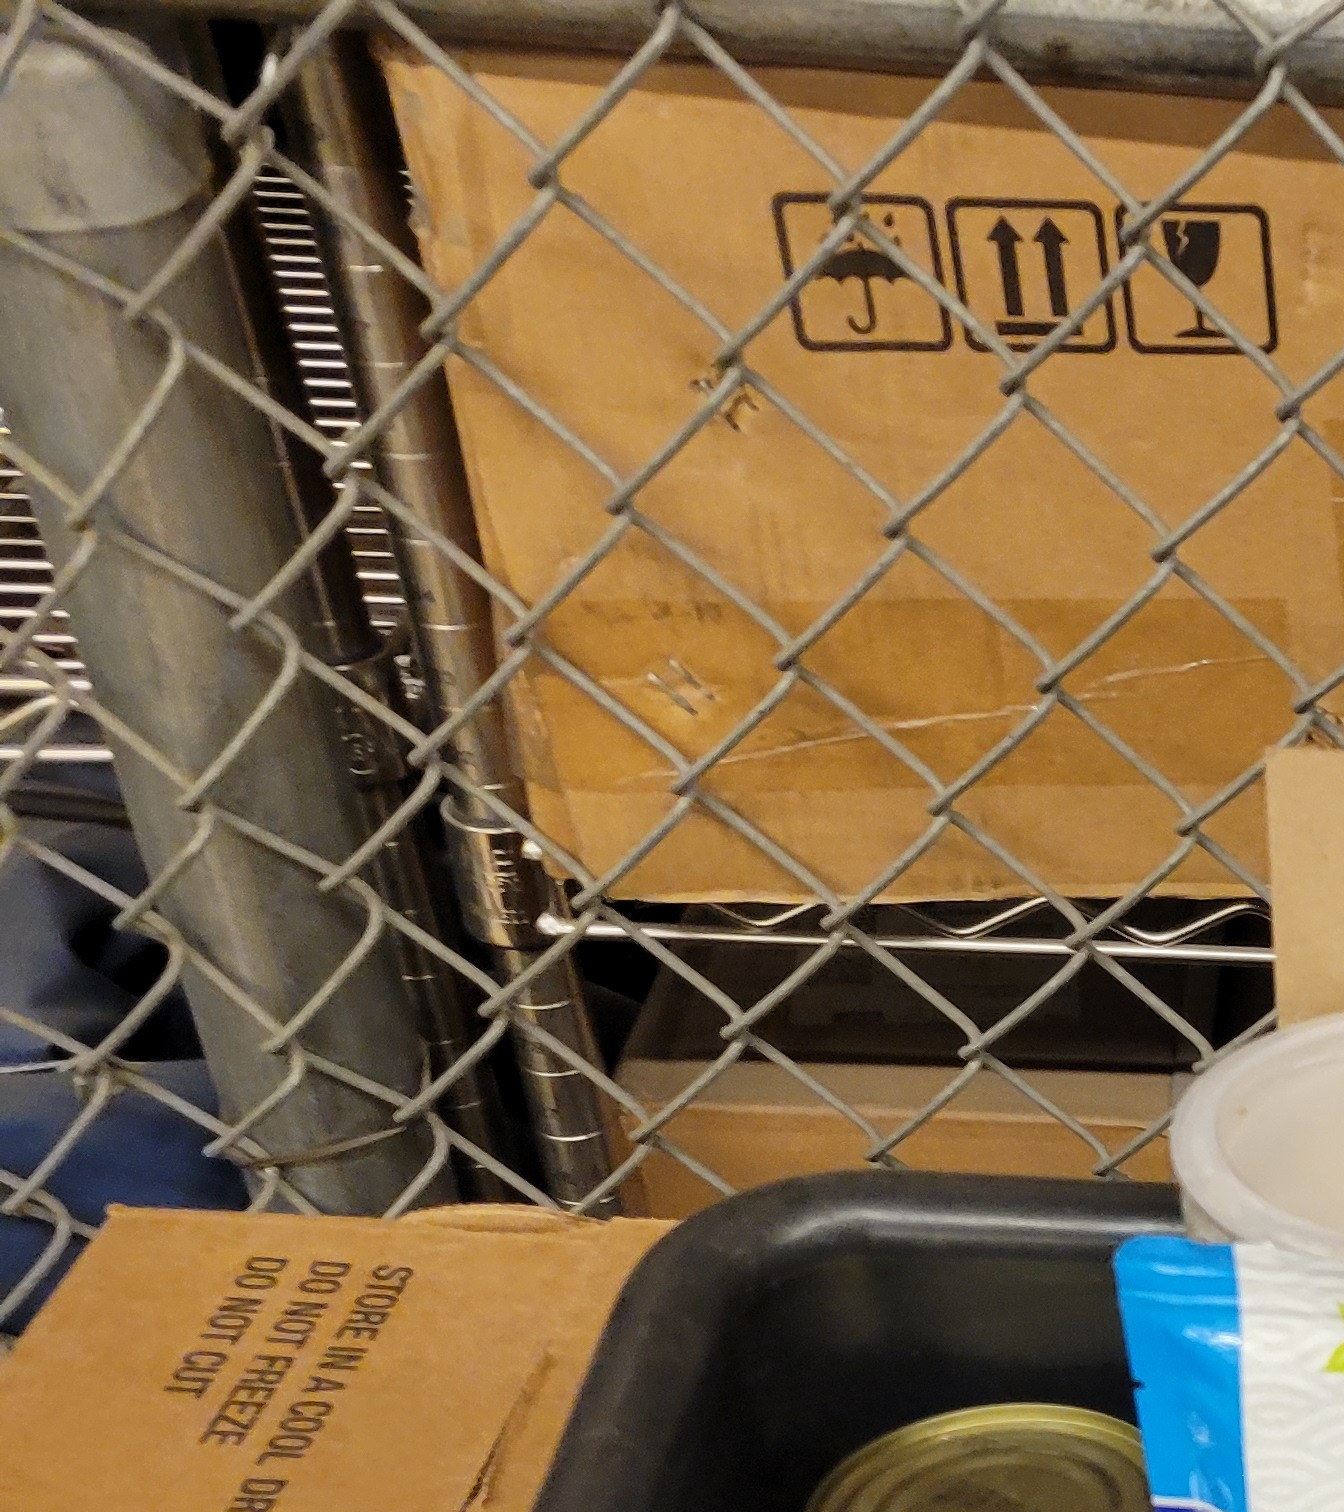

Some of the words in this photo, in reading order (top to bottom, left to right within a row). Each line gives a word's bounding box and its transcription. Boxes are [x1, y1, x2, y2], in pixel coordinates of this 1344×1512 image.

[234, 1255, 290, 1291] DO
[298, 1259, 354, 1295] DO
[200, 1296, 264, 1346] NOT
[264, 1300, 330, 1350] NOT
[333, 1264, 415, 1342] STORE
[163, 1350, 229, 1400] CUT
[317, 1345, 369, 1372] IN
[199, 1354, 297, 1447] FREEZE
[300, 1376, 347, 1393] A
[255, 1400, 335, 1466] COOL
